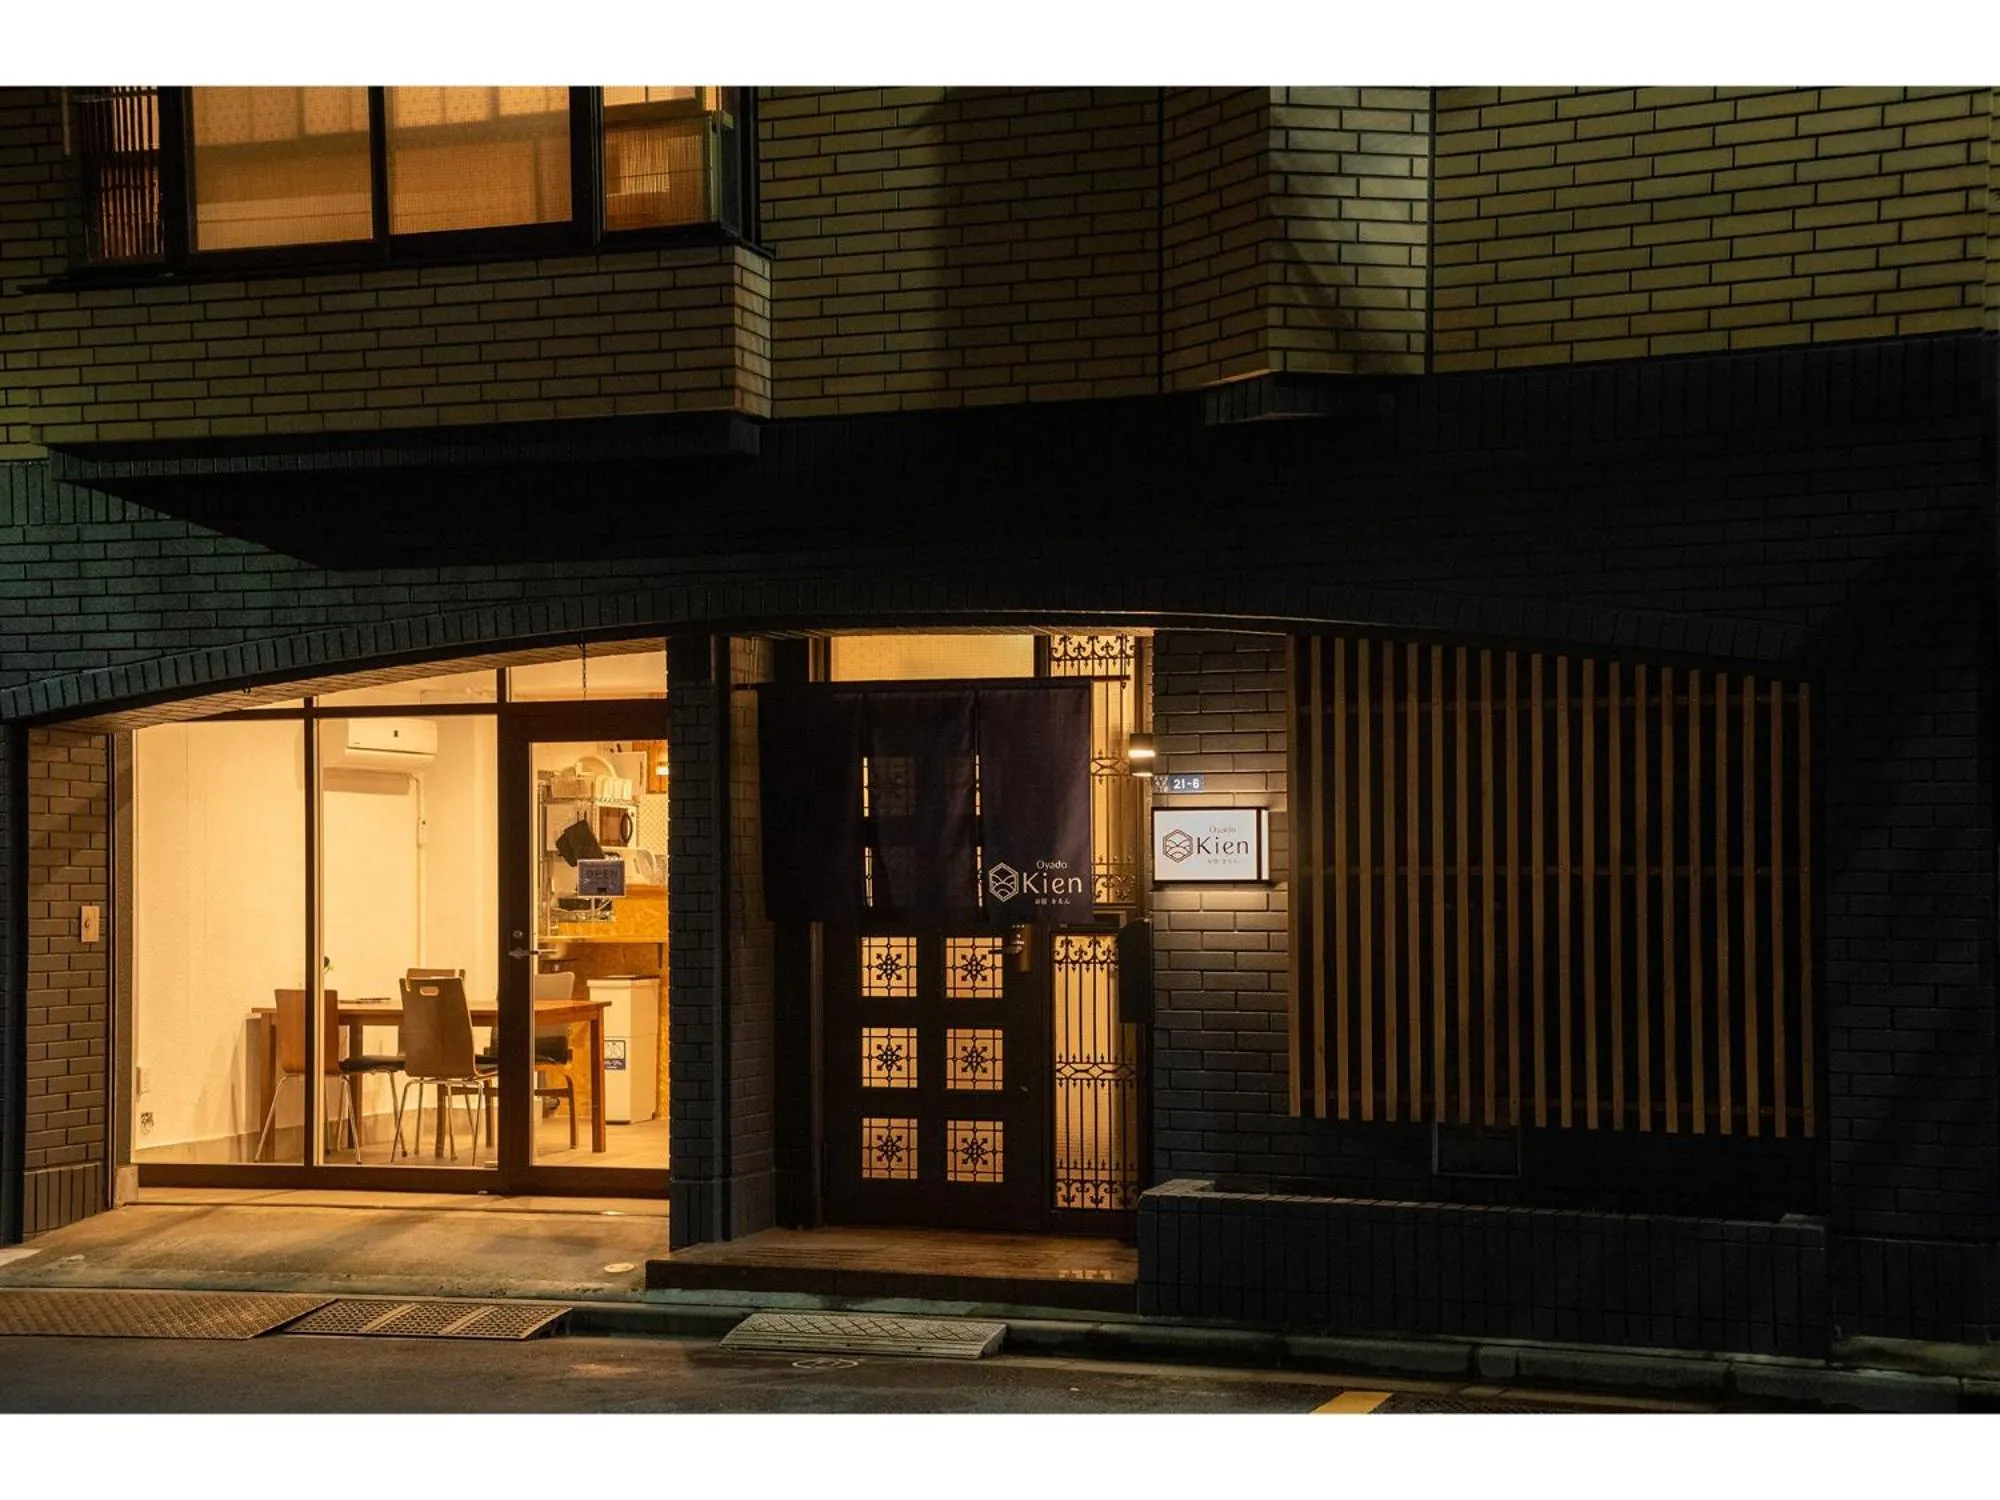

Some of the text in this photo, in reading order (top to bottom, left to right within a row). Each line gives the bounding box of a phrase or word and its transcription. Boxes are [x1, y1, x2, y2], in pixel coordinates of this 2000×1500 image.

[1173, 778, 1200, 789] 21-6
[1197, 836, 1249, 855] Kien
[1036, 860, 1068, 870] Oyado
[1023, 872, 1082, 894] Kien
